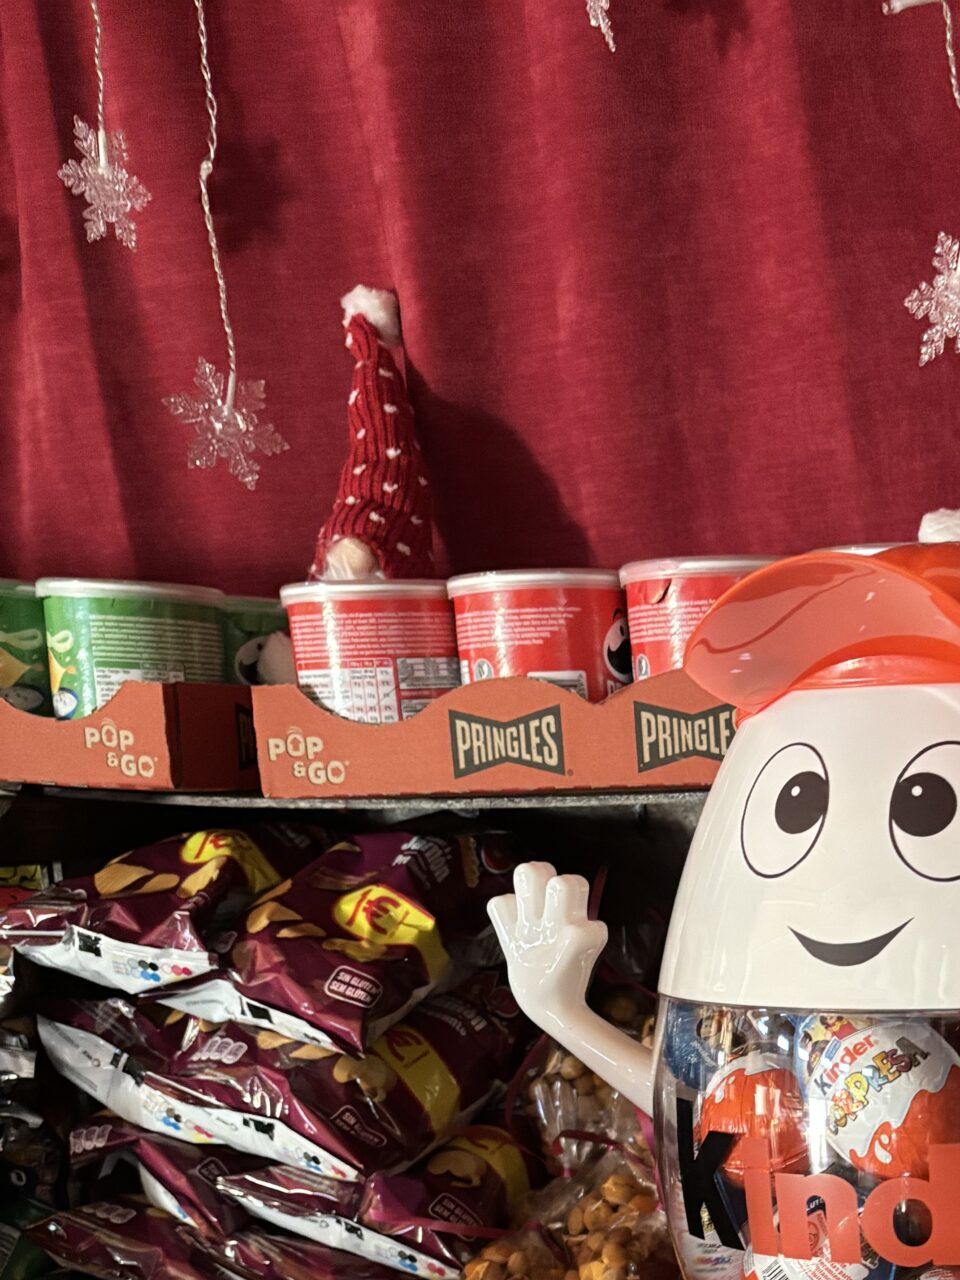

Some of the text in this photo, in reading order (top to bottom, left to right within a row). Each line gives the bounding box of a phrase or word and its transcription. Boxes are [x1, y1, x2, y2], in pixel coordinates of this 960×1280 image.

[84, 724, 135, 751] POP
[268, 733, 324, 761] POP
[455, 714, 559, 770] PRINGLES
[639, 709, 738, 763] PRINGLE
